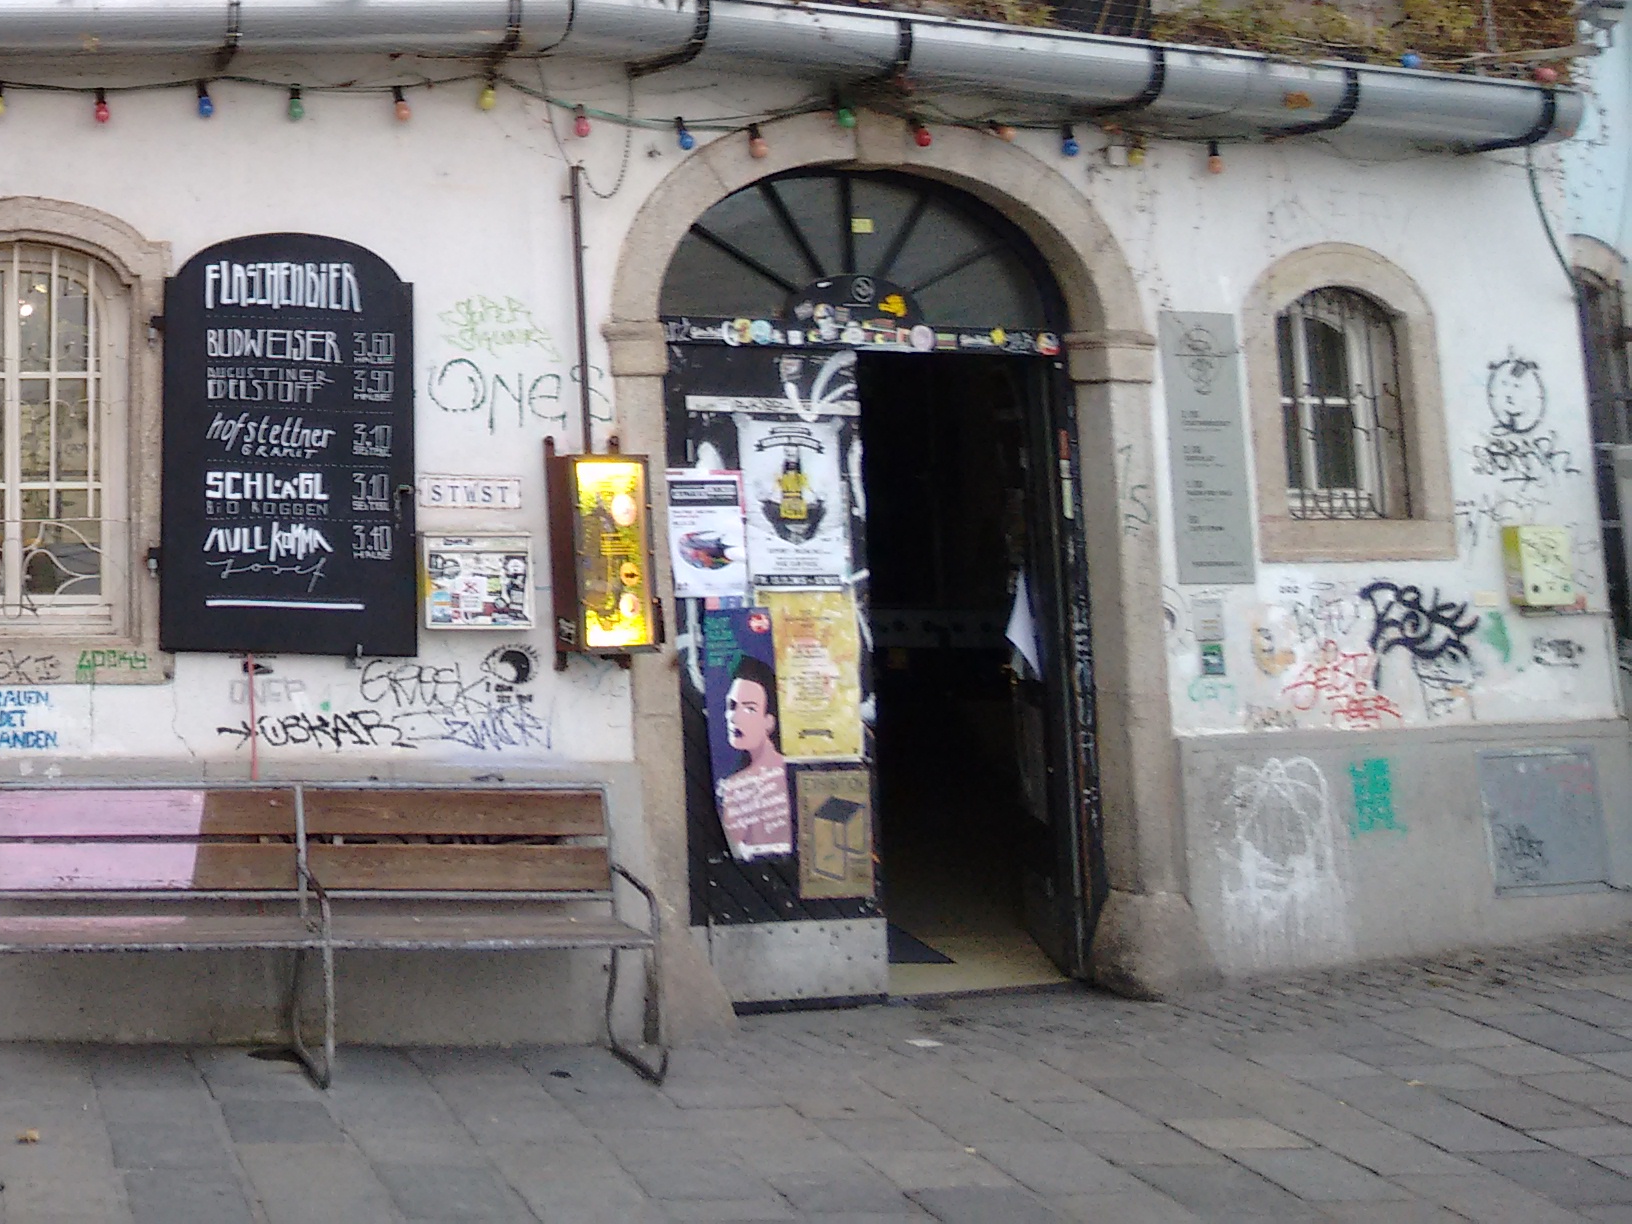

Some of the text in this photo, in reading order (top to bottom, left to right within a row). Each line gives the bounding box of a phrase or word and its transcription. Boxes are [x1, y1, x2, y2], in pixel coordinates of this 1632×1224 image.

[206, 328, 344, 365] BUDWEISER
[206, 367, 336, 384] AUGUSTINER
[206, 379, 325, 404] EDELSTOFF
[206, 412, 337, 452] hofstettner
[205, 471, 330, 501] SCHLÄGL
[431, 484, 510, 505] STWST
[251, 500, 329, 516] ROGGEN
[203, 526, 268, 554] NULL
[269, 521, 334, 563] KOMMA
